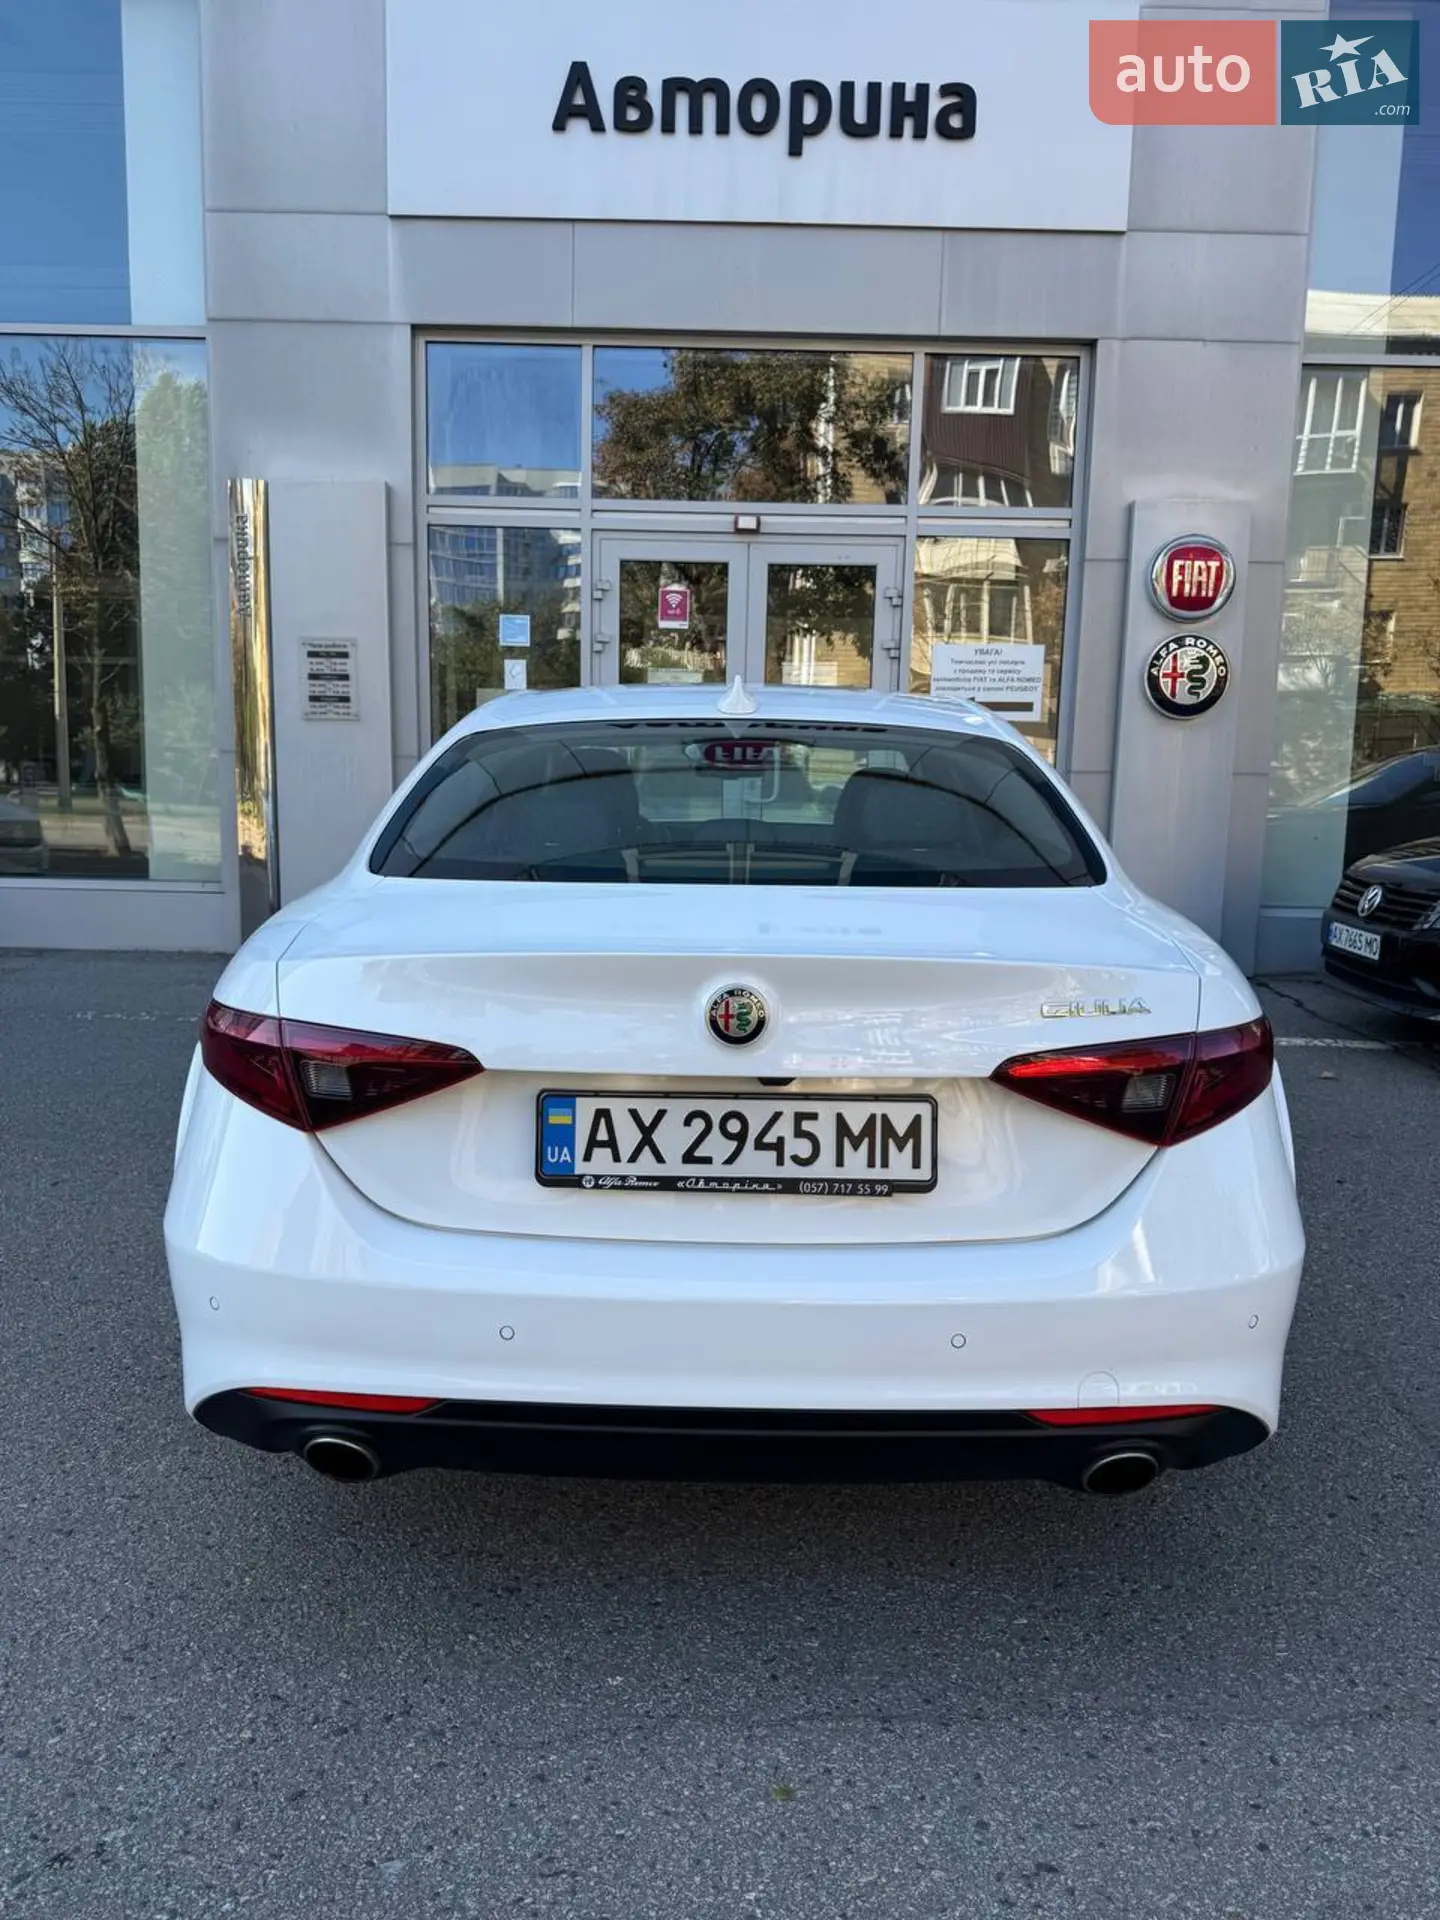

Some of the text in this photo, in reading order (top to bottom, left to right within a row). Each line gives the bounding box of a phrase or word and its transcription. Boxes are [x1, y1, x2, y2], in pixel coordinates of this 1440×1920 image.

[551, 60, 978, 158] Авторина
[1171, 559, 1220, 598] FIAT
[1150, 636, 1226, 677] ALFA ROMEO
[1041, 997, 1152, 1019] GIULIA
[547, 1146, 572, 1164] UA
[582, 1107, 922, 1170] AX 2945 MM
[799, 1182, 889, 1196] (057) 717 55 99
